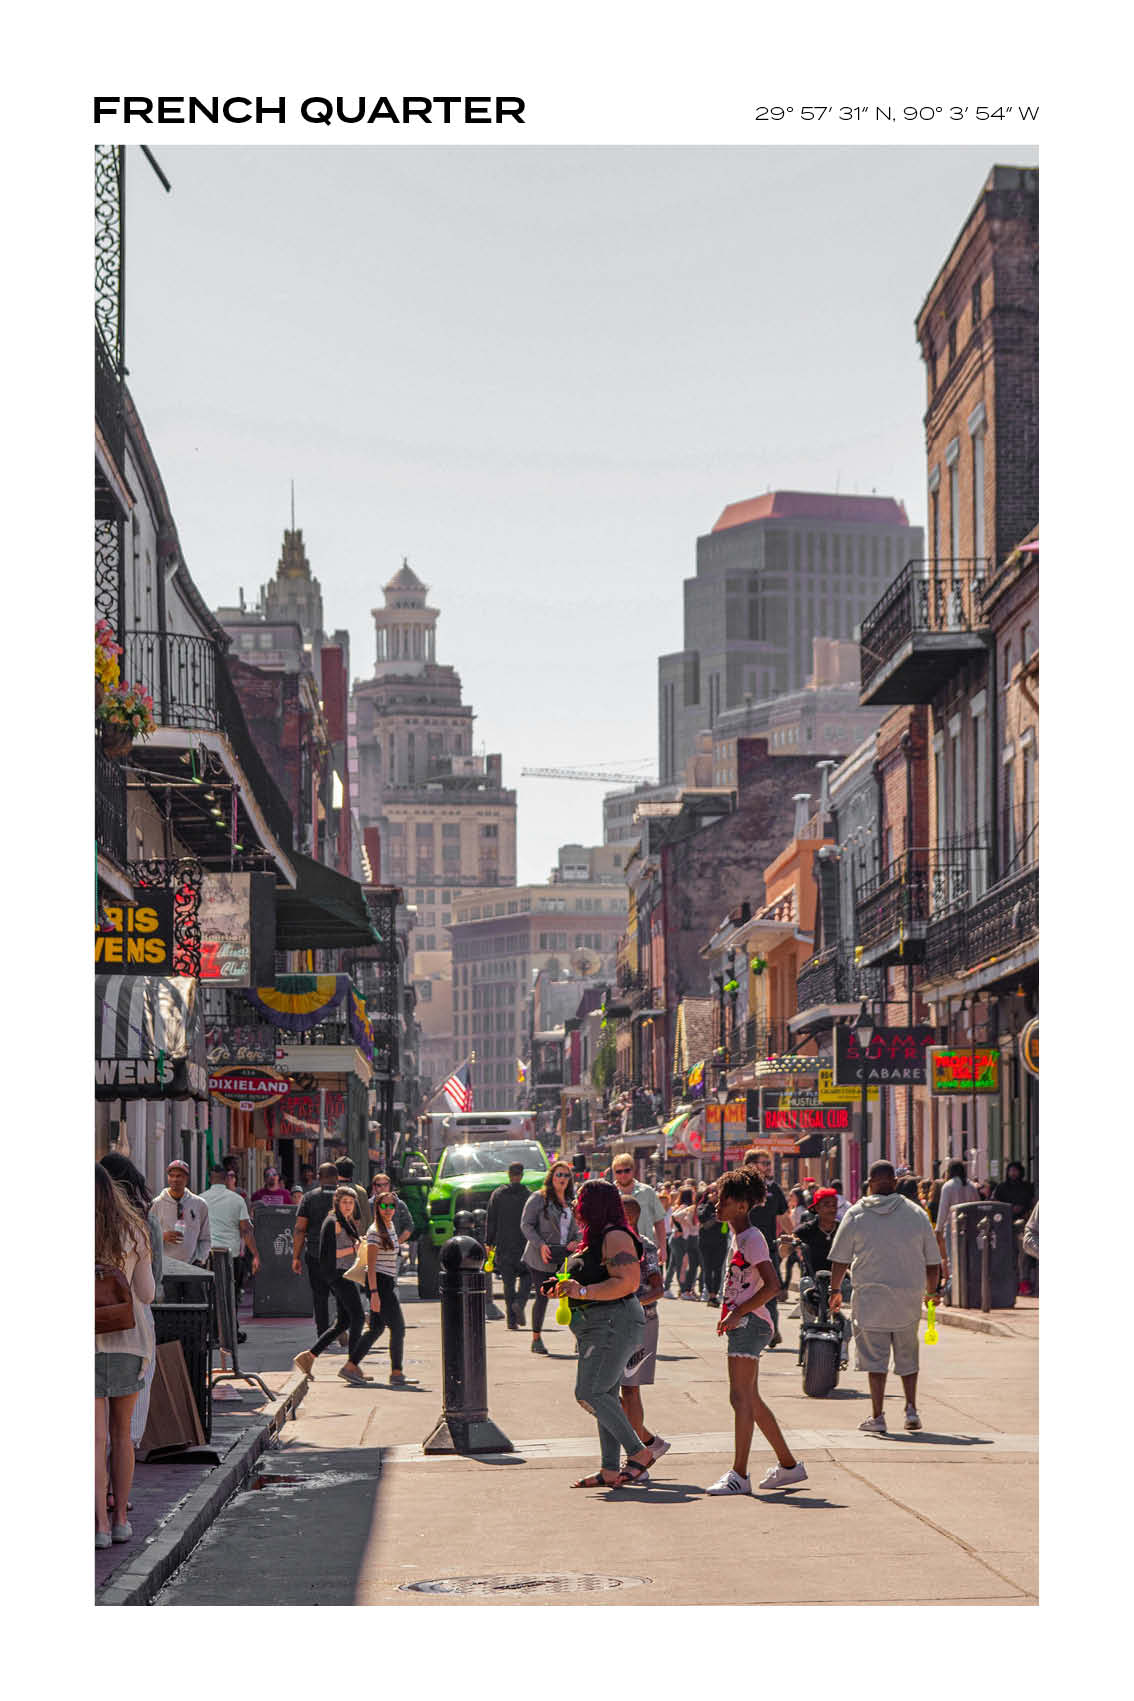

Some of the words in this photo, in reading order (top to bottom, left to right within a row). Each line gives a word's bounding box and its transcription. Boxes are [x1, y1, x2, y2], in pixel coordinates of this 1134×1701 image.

[95, 907, 159, 933] RIS
[847, 1047, 927, 1059] SUTR
[208, 1079, 289, 1093] DIXIELAND
[765, 1110, 797, 1128] BARELY
[799, 1110, 826, 1128] LEGAL
[827, 1110, 849, 1128] CLUB
